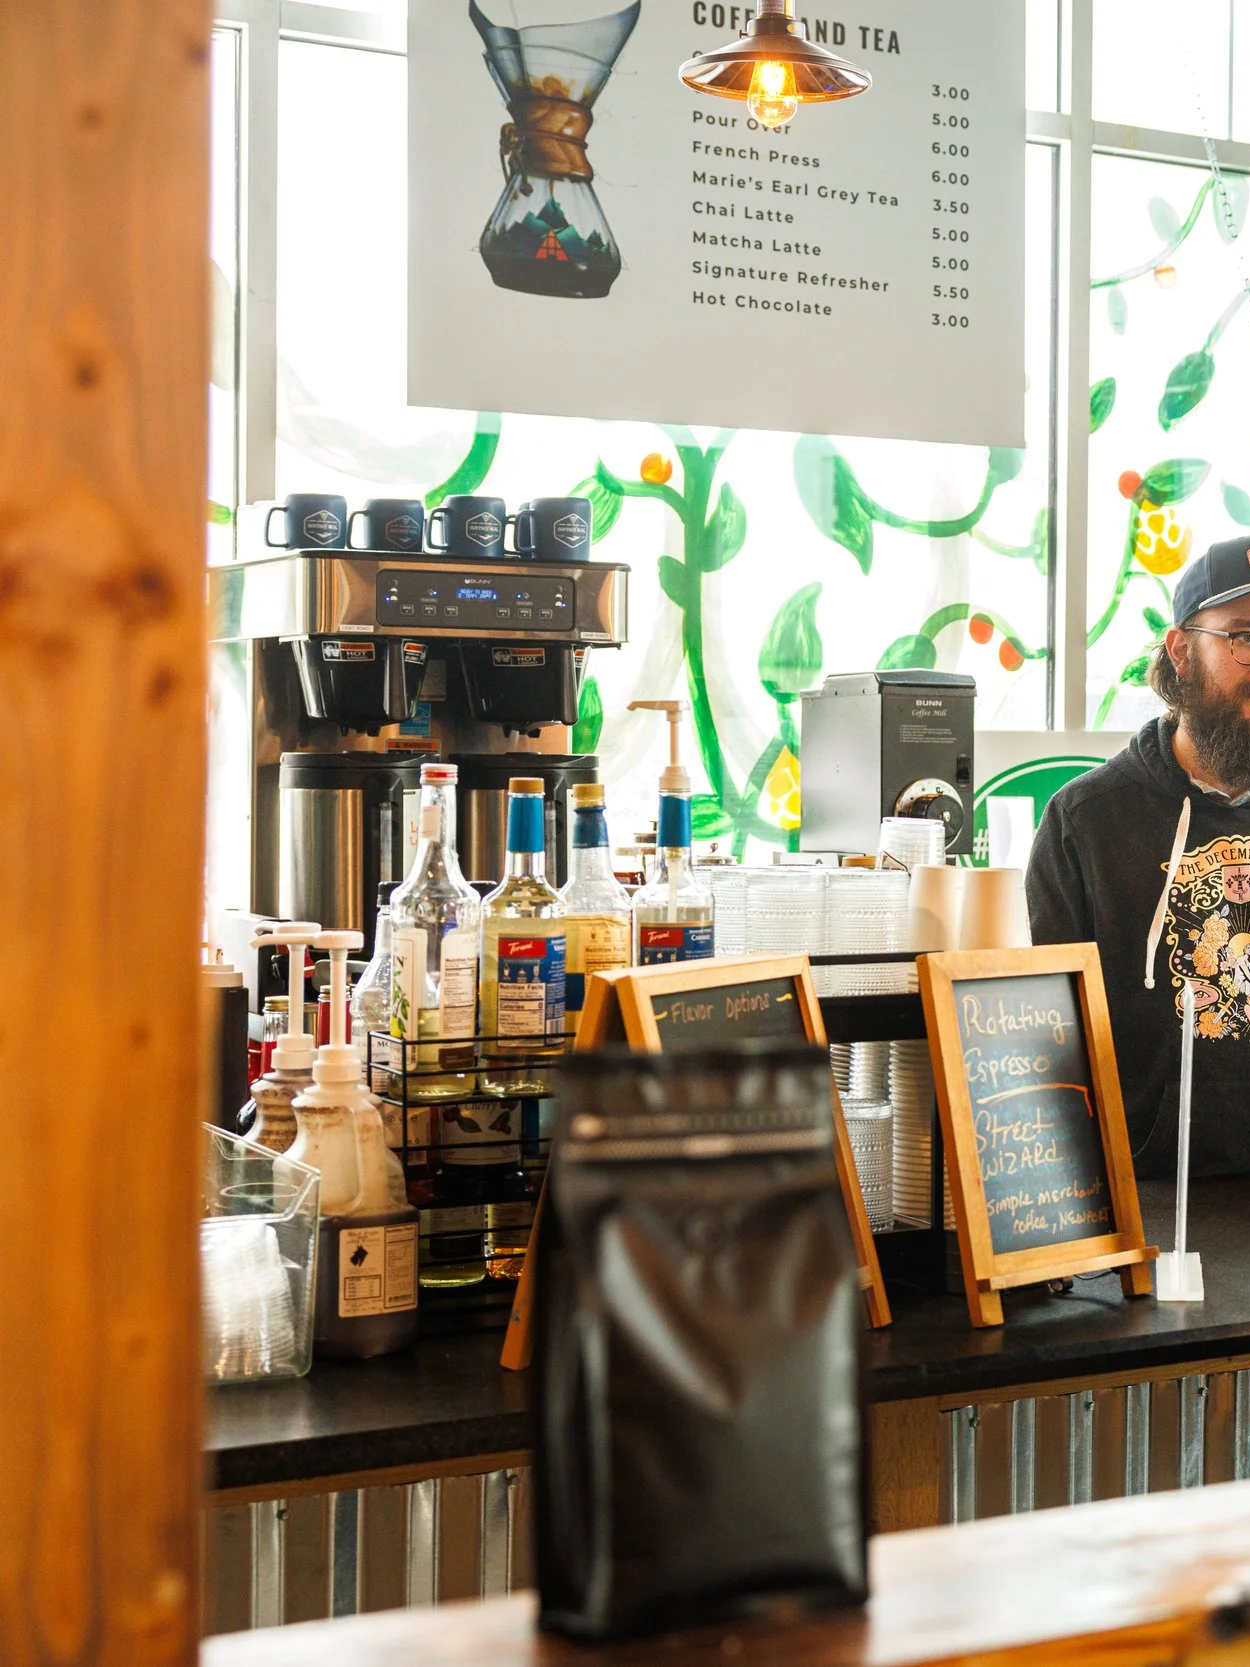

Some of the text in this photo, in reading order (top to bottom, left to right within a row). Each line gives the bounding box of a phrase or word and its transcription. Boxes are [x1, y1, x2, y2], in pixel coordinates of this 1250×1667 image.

[801, 17, 846, 46] AND
[858, 26, 900, 54] TEA
[932, 84, 969, 101] 3.00
[693, 110, 737, 128] Pour
[932, 113, 969, 130] 5.00
[693, 140, 820, 168] French Press
[932, 142, 969, 158] 6.00
[932, 170, 969, 187] 6.00
[692, 170, 899, 206] Marie's Earl Grey Tea
[692, 201, 794, 223] Chai Latte
[933, 199, 969, 215] 3.50
[692, 230, 822, 256] Matcha Latte
[932, 227, 969, 244] 5.00
[932, 256, 969, 272] 5.00
[692, 260, 890, 292] Signature Refresher
[933, 284, 969, 301] 5.50
[692, 290, 832, 315] Hot Chocolate
[932, 313, 969, 329] 3.00
[915, 699, 942, 707] BUNN
[911, 708, 948, 719] Coffee Mill
[1179, 861, 1205, 876] THE
[507, 940, 534, 956] Torani
[499, 1002, 525, 1010] Calories
[671, 1000, 714, 1025] Flavor
[962, 995, 1074, 1046] Rotating
[963, 1047, 1051, 1088] Espresso
